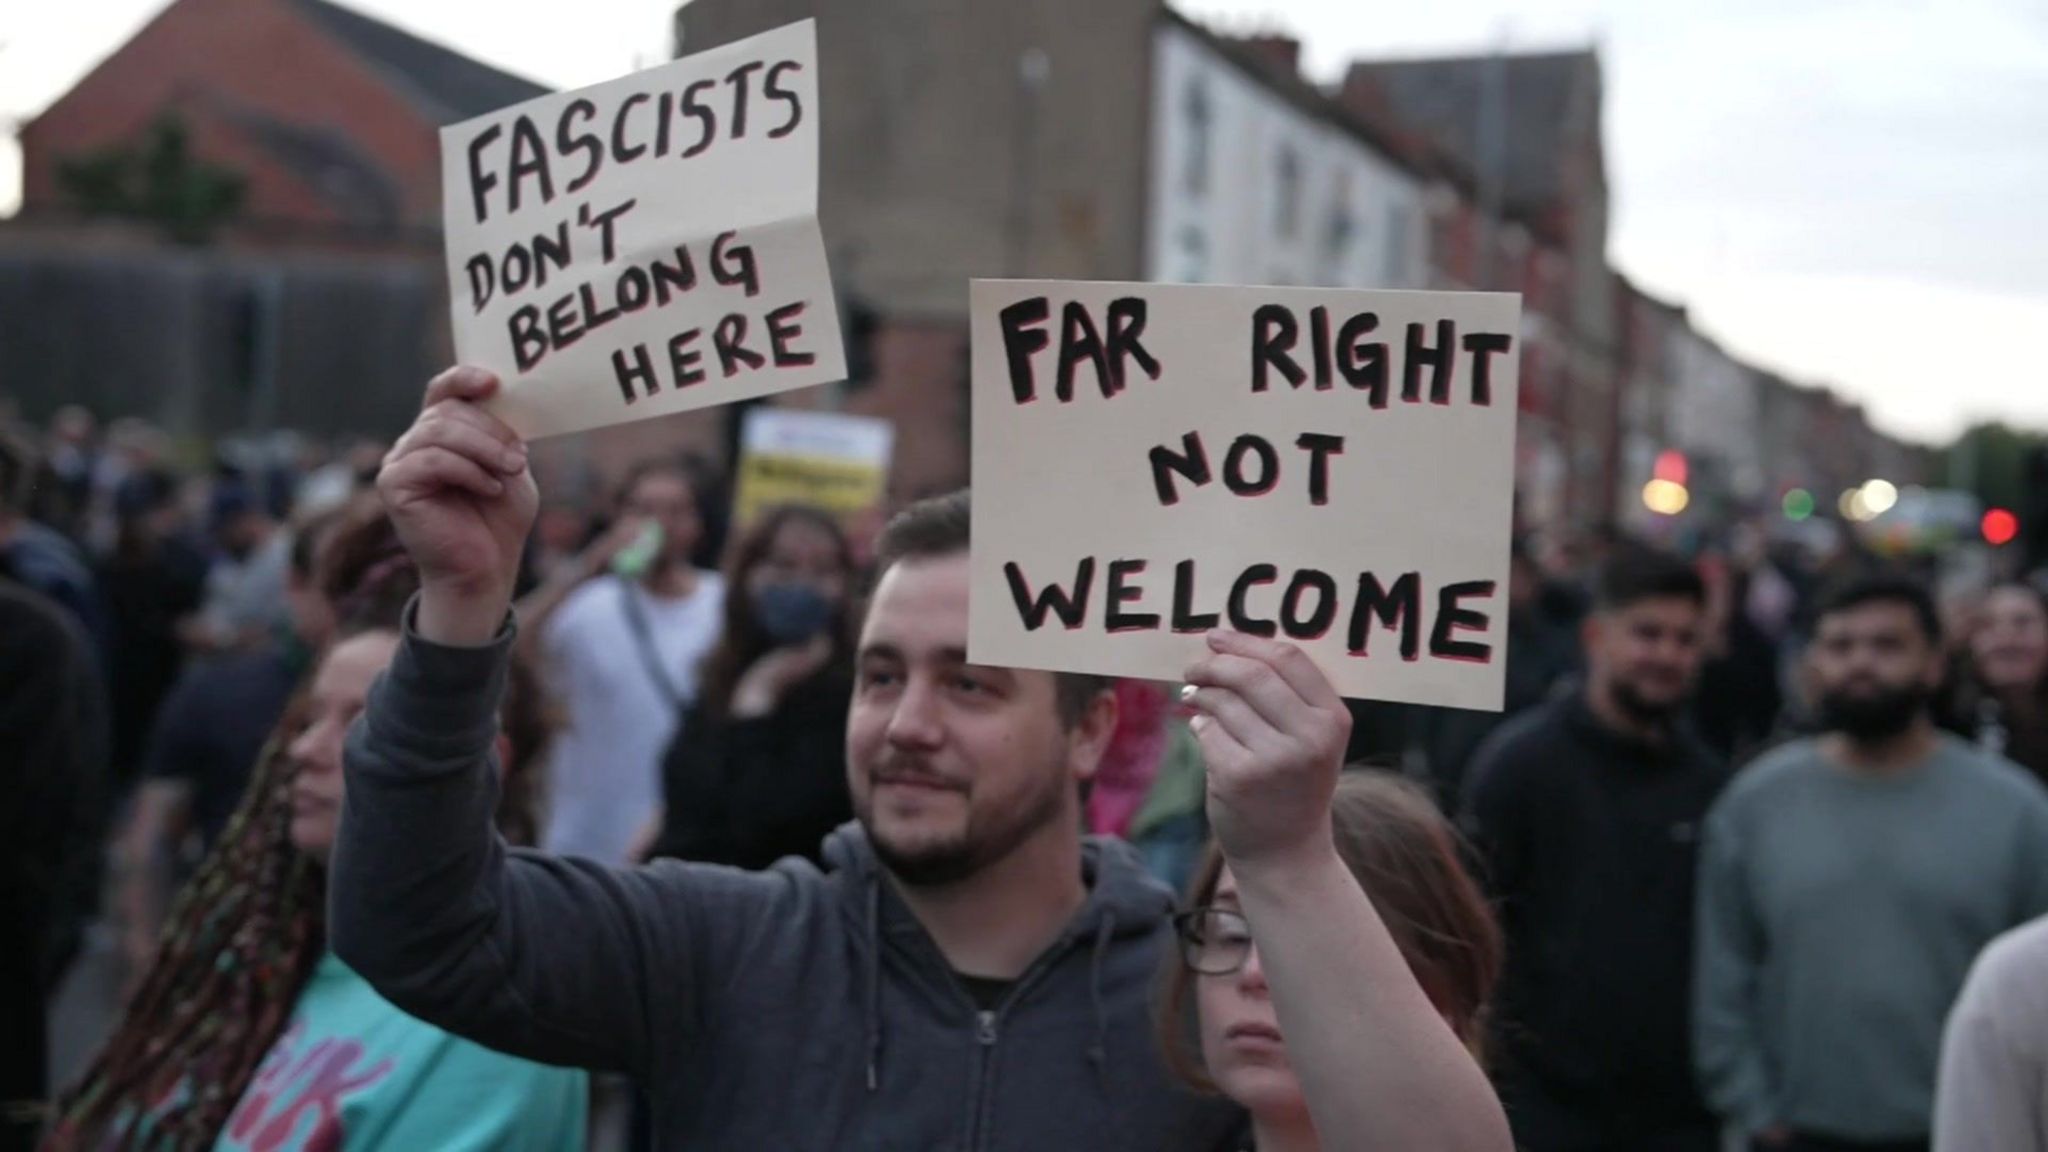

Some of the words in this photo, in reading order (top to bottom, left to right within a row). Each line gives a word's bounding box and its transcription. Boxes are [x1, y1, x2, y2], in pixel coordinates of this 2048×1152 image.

[467, 60, 802, 223] FASCISTS
[465, 199, 636, 313] DON'T
[508, 231, 760, 373] BELONG
[611, 301, 815, 404] HERE
[1000, 297, 1162, 405] FAR
[1252, 304, 1511, 408] RIGHT
[1148, 431, 1345, 506] NOT
[1004, 557, 1495, 663] WELCOME
